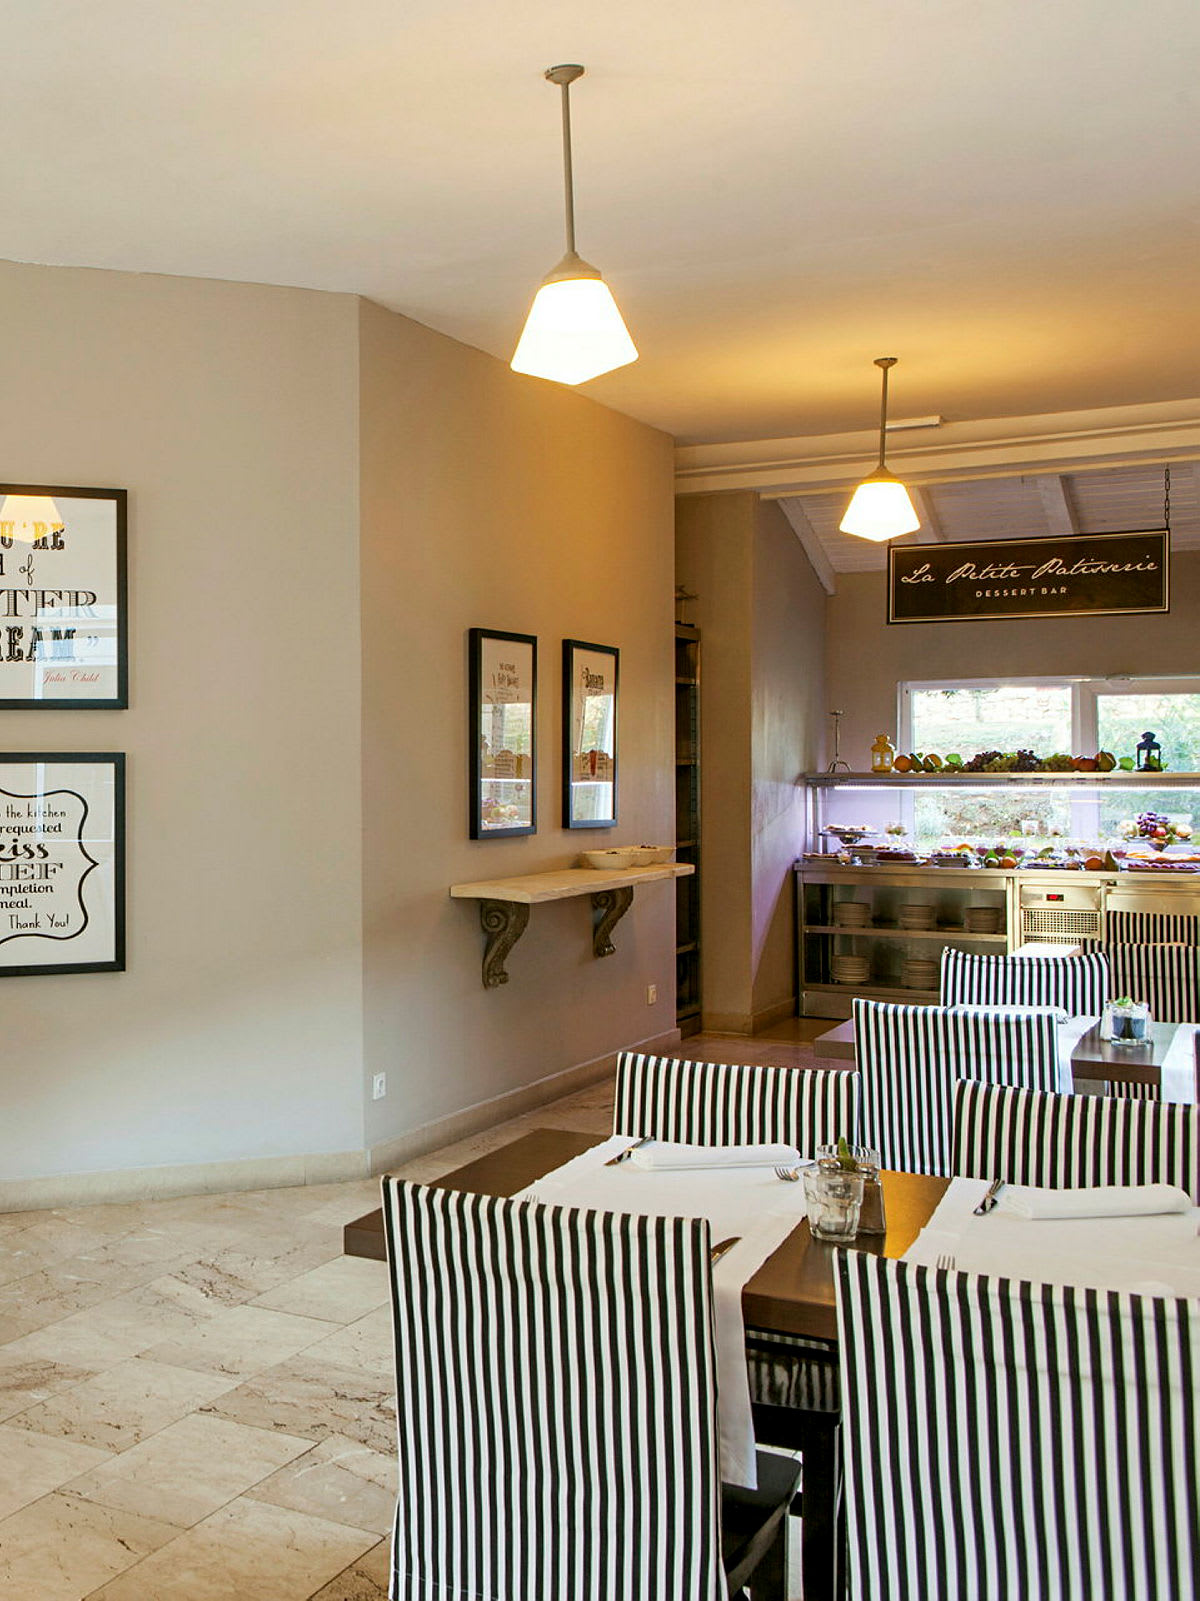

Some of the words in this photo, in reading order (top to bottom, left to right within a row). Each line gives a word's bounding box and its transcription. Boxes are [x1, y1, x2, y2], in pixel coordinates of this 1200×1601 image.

[19, 554, 35, 585] of
[900, 563, 935, 584] La
[945, 562, 1035, 584] Petite
[1032, 555, 1159, 580] Patisserie
[975, 587, 1036, 599] DESSERT
[1041, 586, 1068, 596] BAR
[43, 671, 66, 685] Julia
[70, 669, 100, 683] Child
[6, 803, 23, 818] the
[0, 822, 62, 837] requested
[8, 914, 41, 930] Thank
[47, 913, 70, 929] You!
